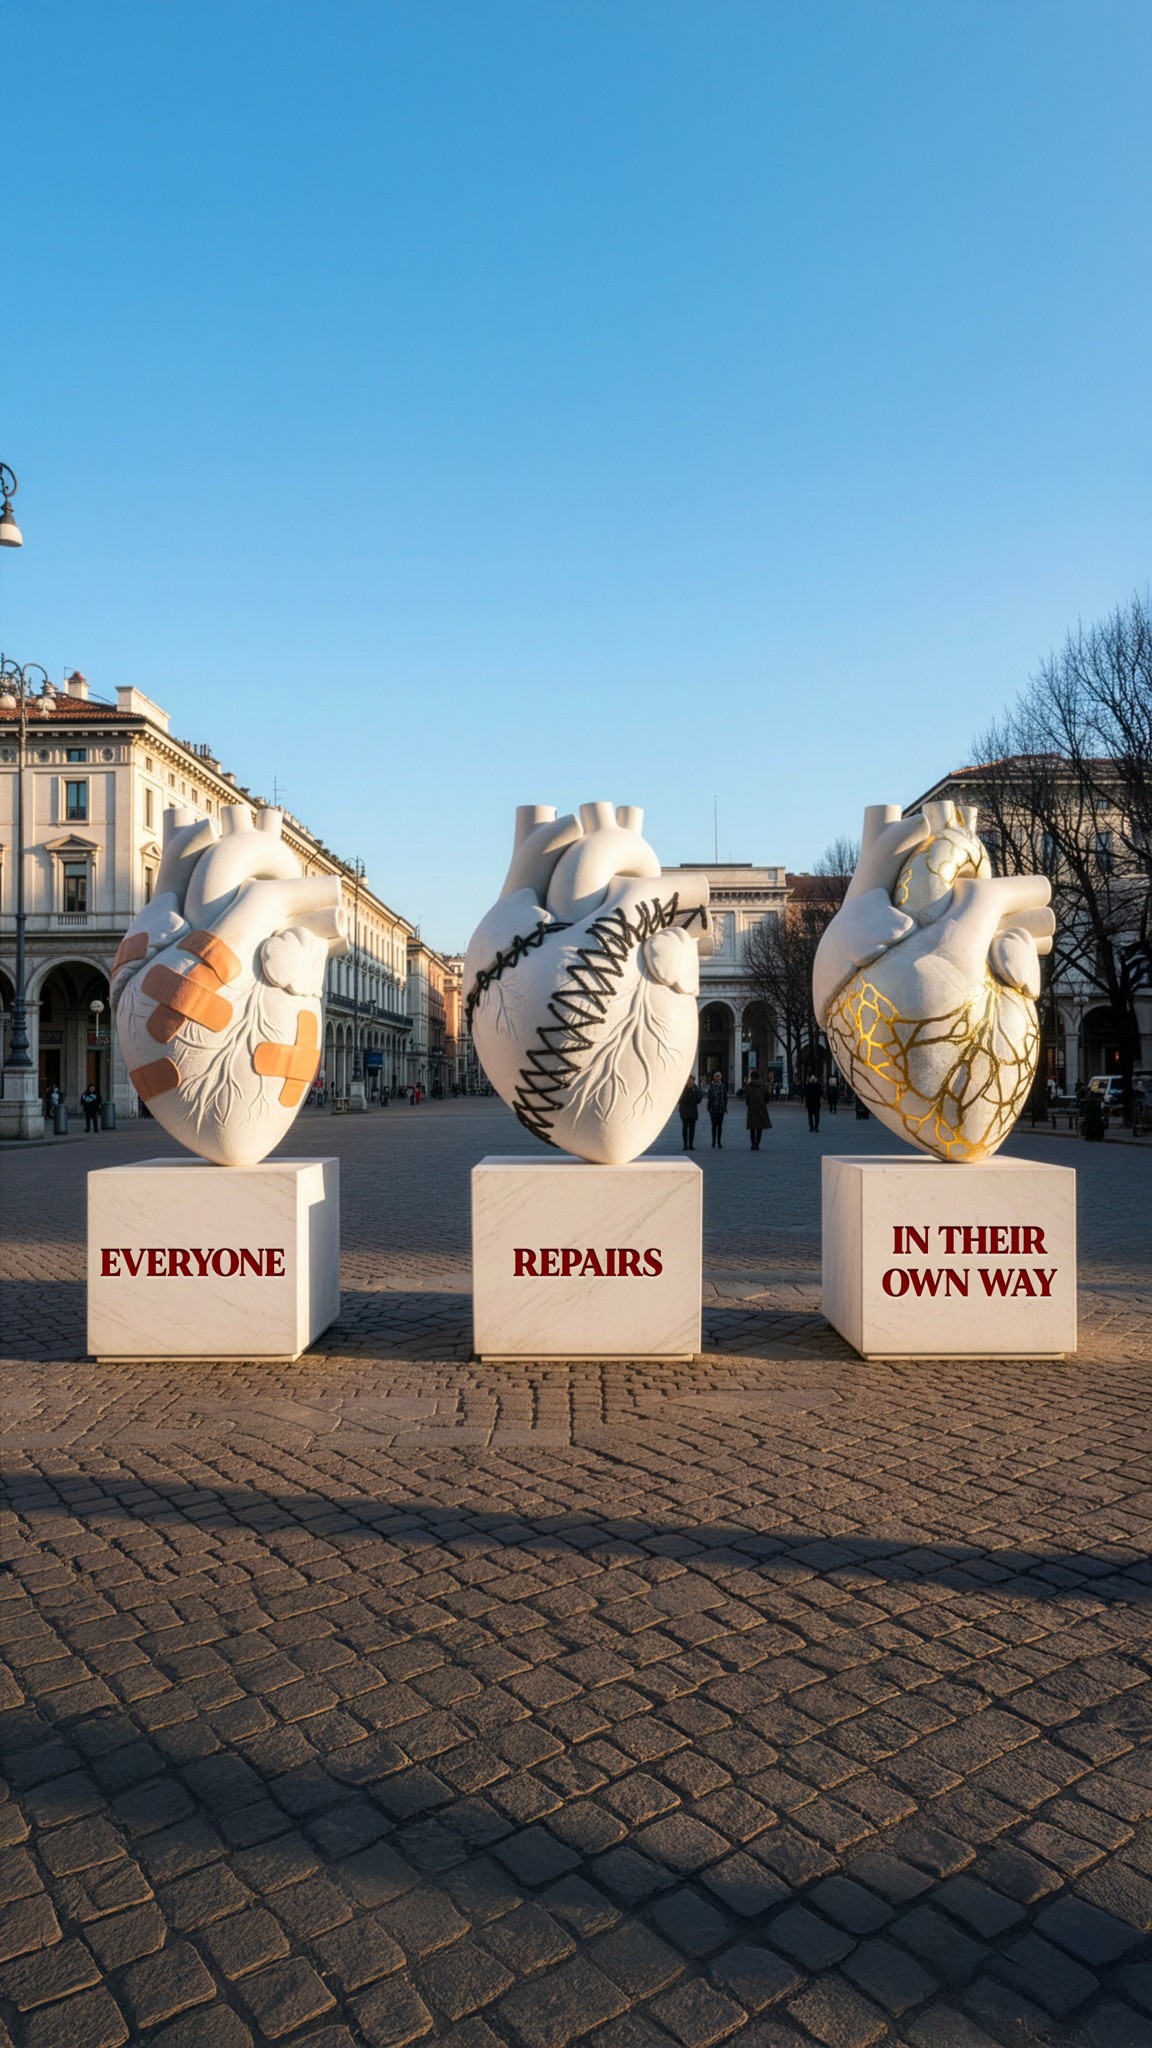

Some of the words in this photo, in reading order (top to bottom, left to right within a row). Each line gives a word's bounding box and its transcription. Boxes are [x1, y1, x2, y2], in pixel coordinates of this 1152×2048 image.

[893, 1225, 930, 1255] IN
[937, 1225, 1048, 1255] THEIR
[100, 1247, 286, 1277] EVERYONE
[512, 1247, 664, 1277] REPAIRS
[881, 1267, 970, 1298] OWN
[977, 1267, 1058, 1298] WAY
